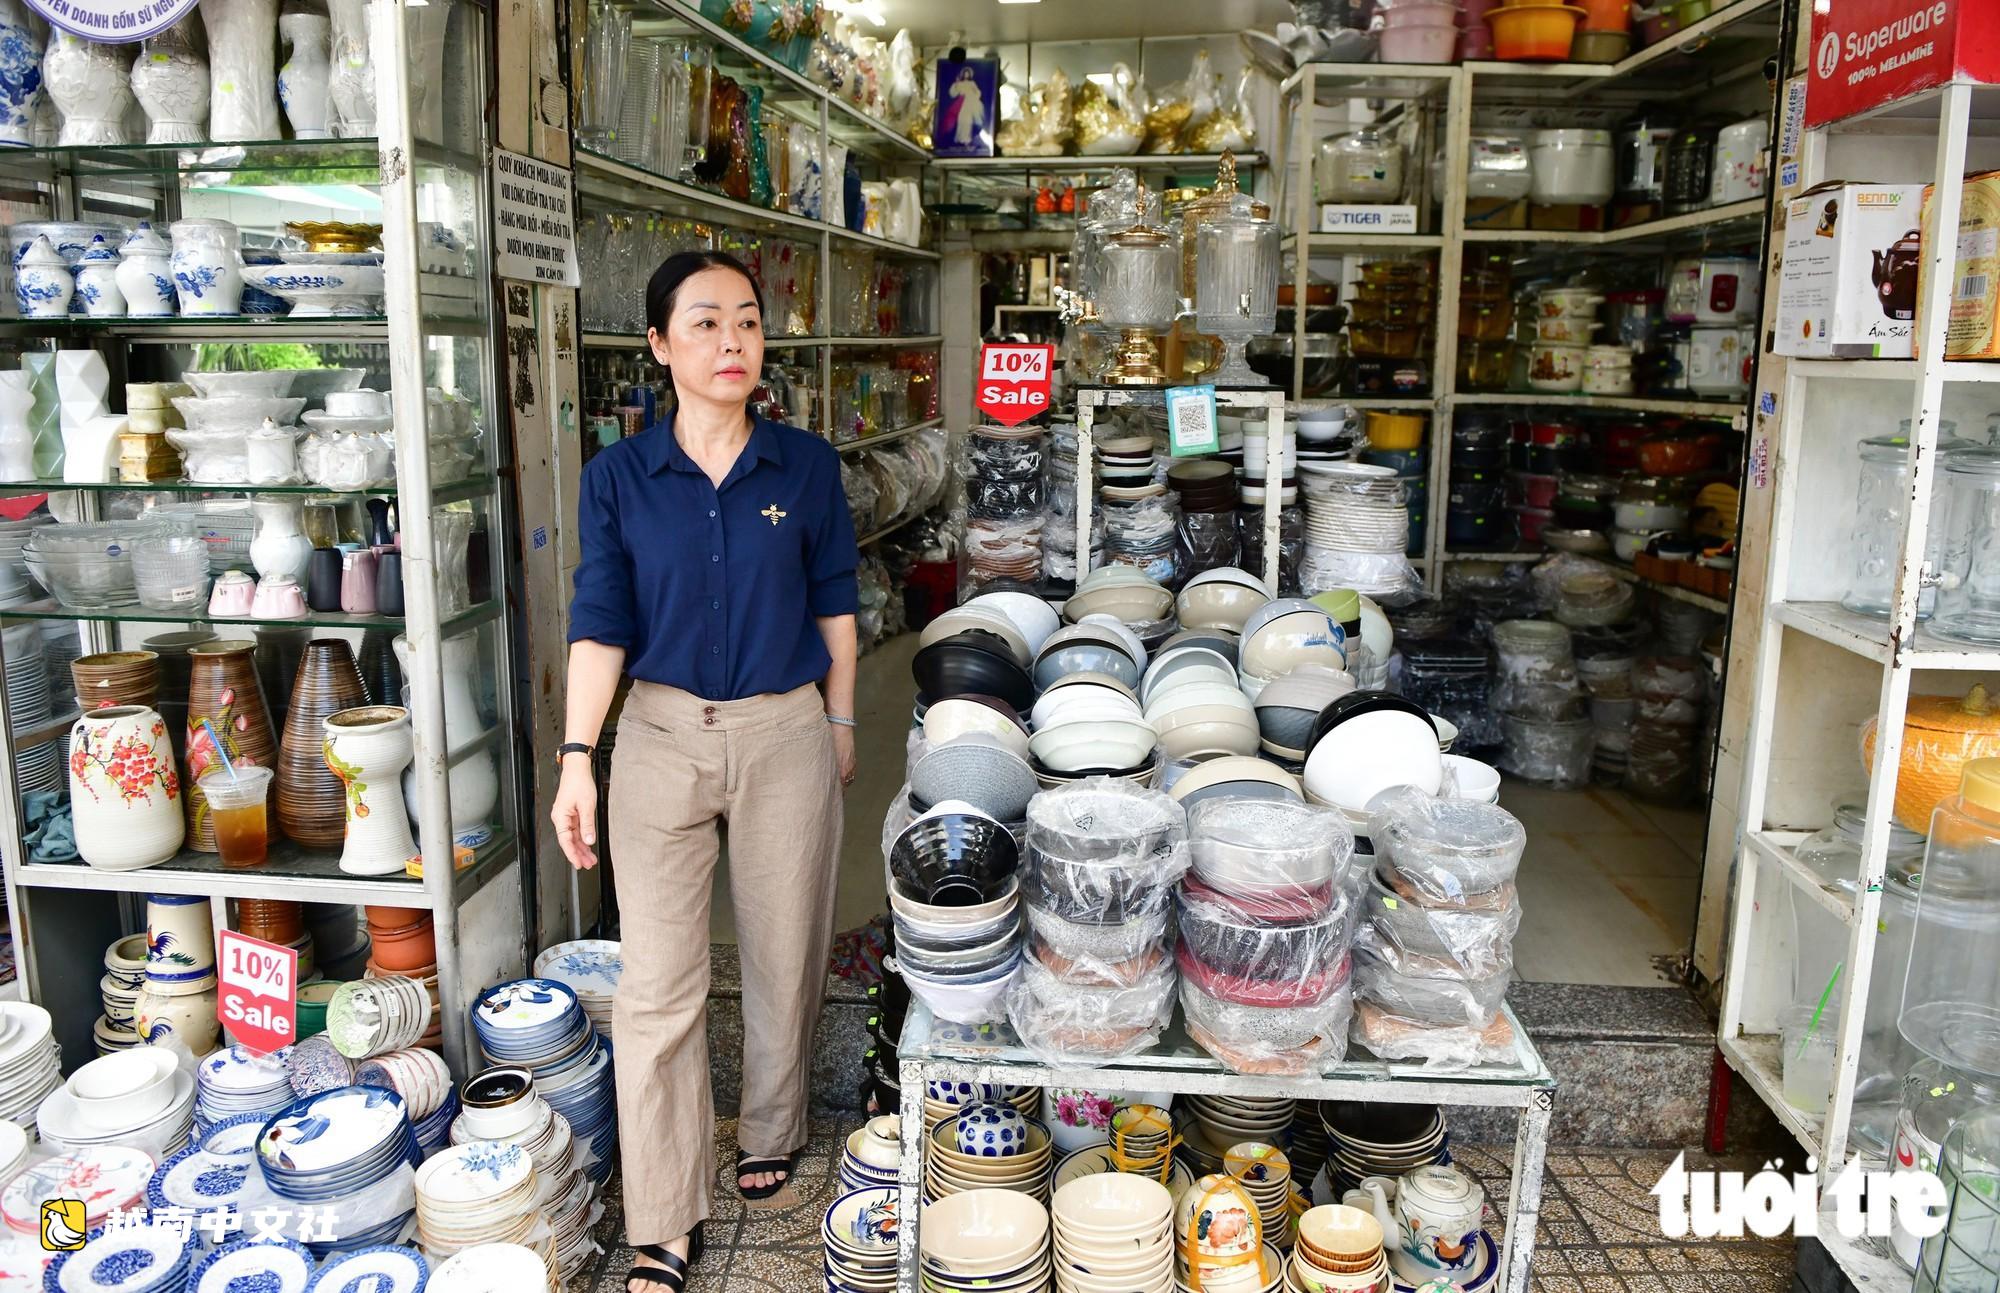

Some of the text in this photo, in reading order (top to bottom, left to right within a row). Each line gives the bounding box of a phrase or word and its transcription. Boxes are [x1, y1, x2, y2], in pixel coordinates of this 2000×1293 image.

[71, 6, 109, 29] DOANH
[112, 10, 136, 29] GỐM
[138, 4, 153, 25] SỨ
[1844, 1, 1947, 62] Superware
[1848, 41, 1934, 87] 100% MELAMINE
[498, 154, 567, 190] QUÝ KHÁCH MUA HÀNG
[501, 182, 511, 200] VUI
[511, 182, 525, 204] LÒNG
[525, 185, 539, 207] KIỂM
[539, 193, 549, 210] TRA
[516, 213, 528, 231] MUA
[1342, 212, 1382, 225] TIGER
[522, 241, 535, 261] MỌI
[535, 241, 551, 261] HÌNH
[535, 265, 546, 279] XIN
[991, 352, 1042, 373] 10%
[981, 385, 1046, 405] Sale
[232, 947, 284, 987] 10%
[223, 994, 290, 1035] Sale
